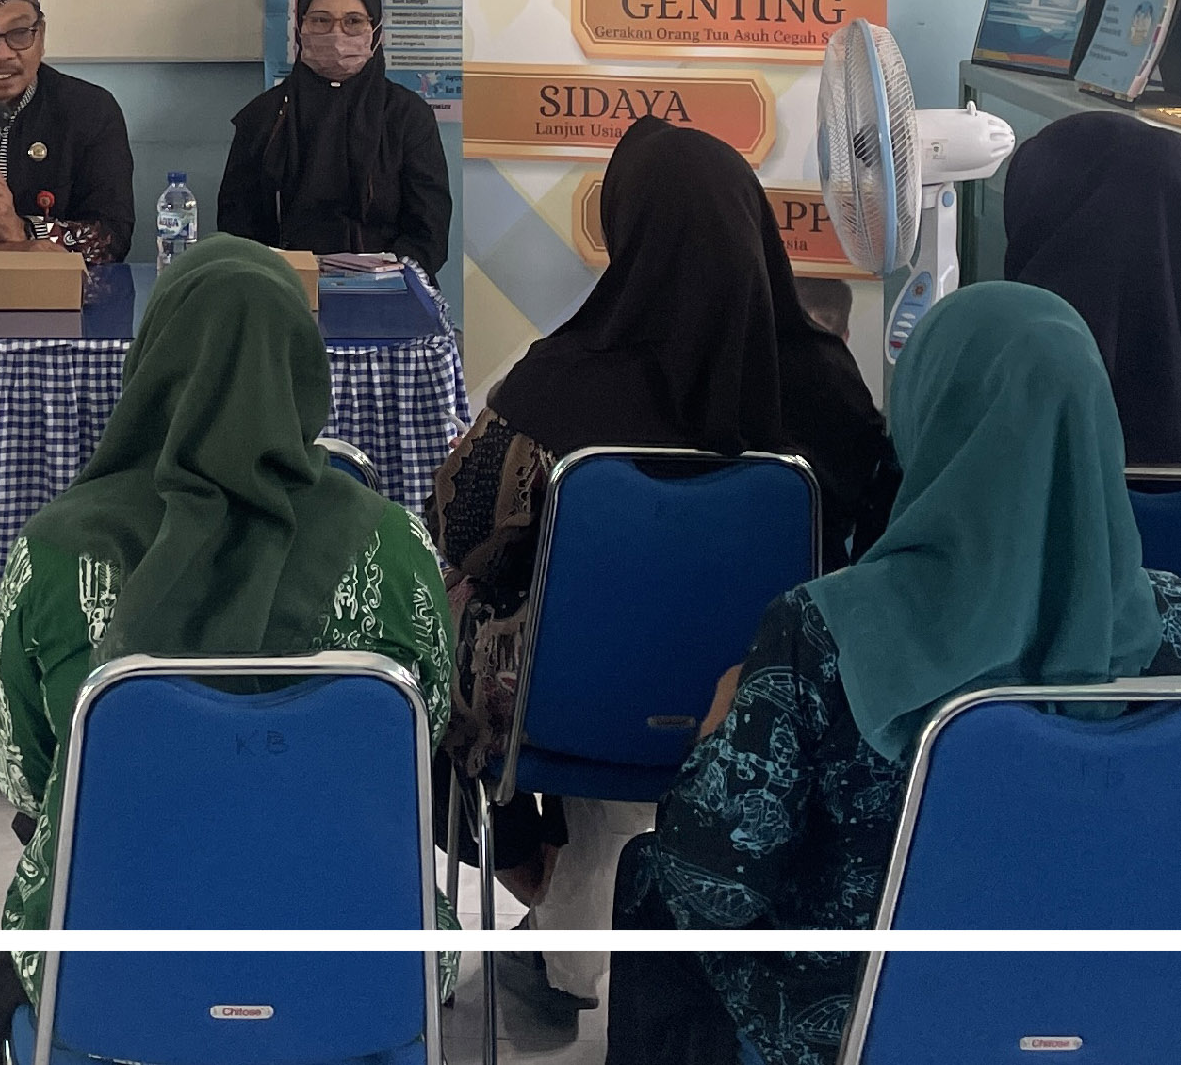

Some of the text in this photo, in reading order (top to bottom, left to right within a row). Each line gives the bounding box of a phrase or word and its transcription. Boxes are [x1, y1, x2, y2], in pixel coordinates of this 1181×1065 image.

[594, 24, 653, 40] Gerakan
[656, 27, 700, 43] Orang
[703, 28, 729, 41] Tua
[734, 28, 769, 42] Asuh
[773, 30, 817, 45] Cegah
[539, 84, 692, 122] SIDAYA
[535, 122, 624, 139] Lanjut Usia
[779, 200, 831, 233] PP
[222, 1007, 261, 1017] Chitose
